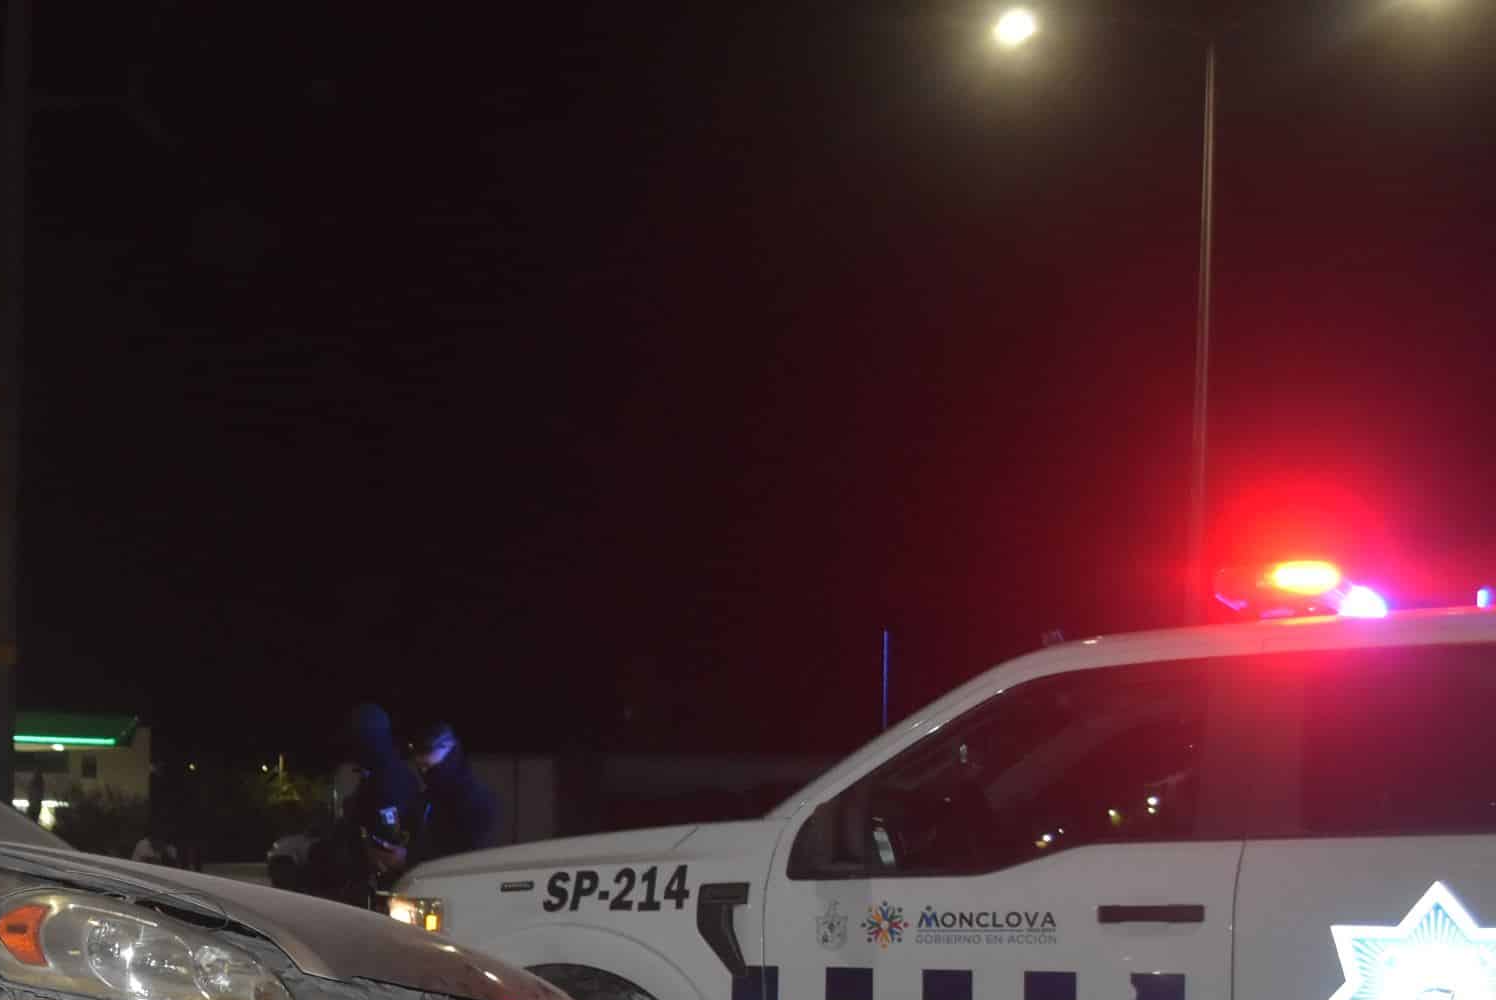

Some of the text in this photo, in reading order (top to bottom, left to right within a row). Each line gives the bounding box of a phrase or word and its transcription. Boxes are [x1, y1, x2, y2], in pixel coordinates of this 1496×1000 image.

[543, 864, 690, 912] SP-214
[917, 905, 1057, 928] MONCLOVA
[915, 934, 981, 945] GOBIERNO
[985, 934, 1003, 945] EN
